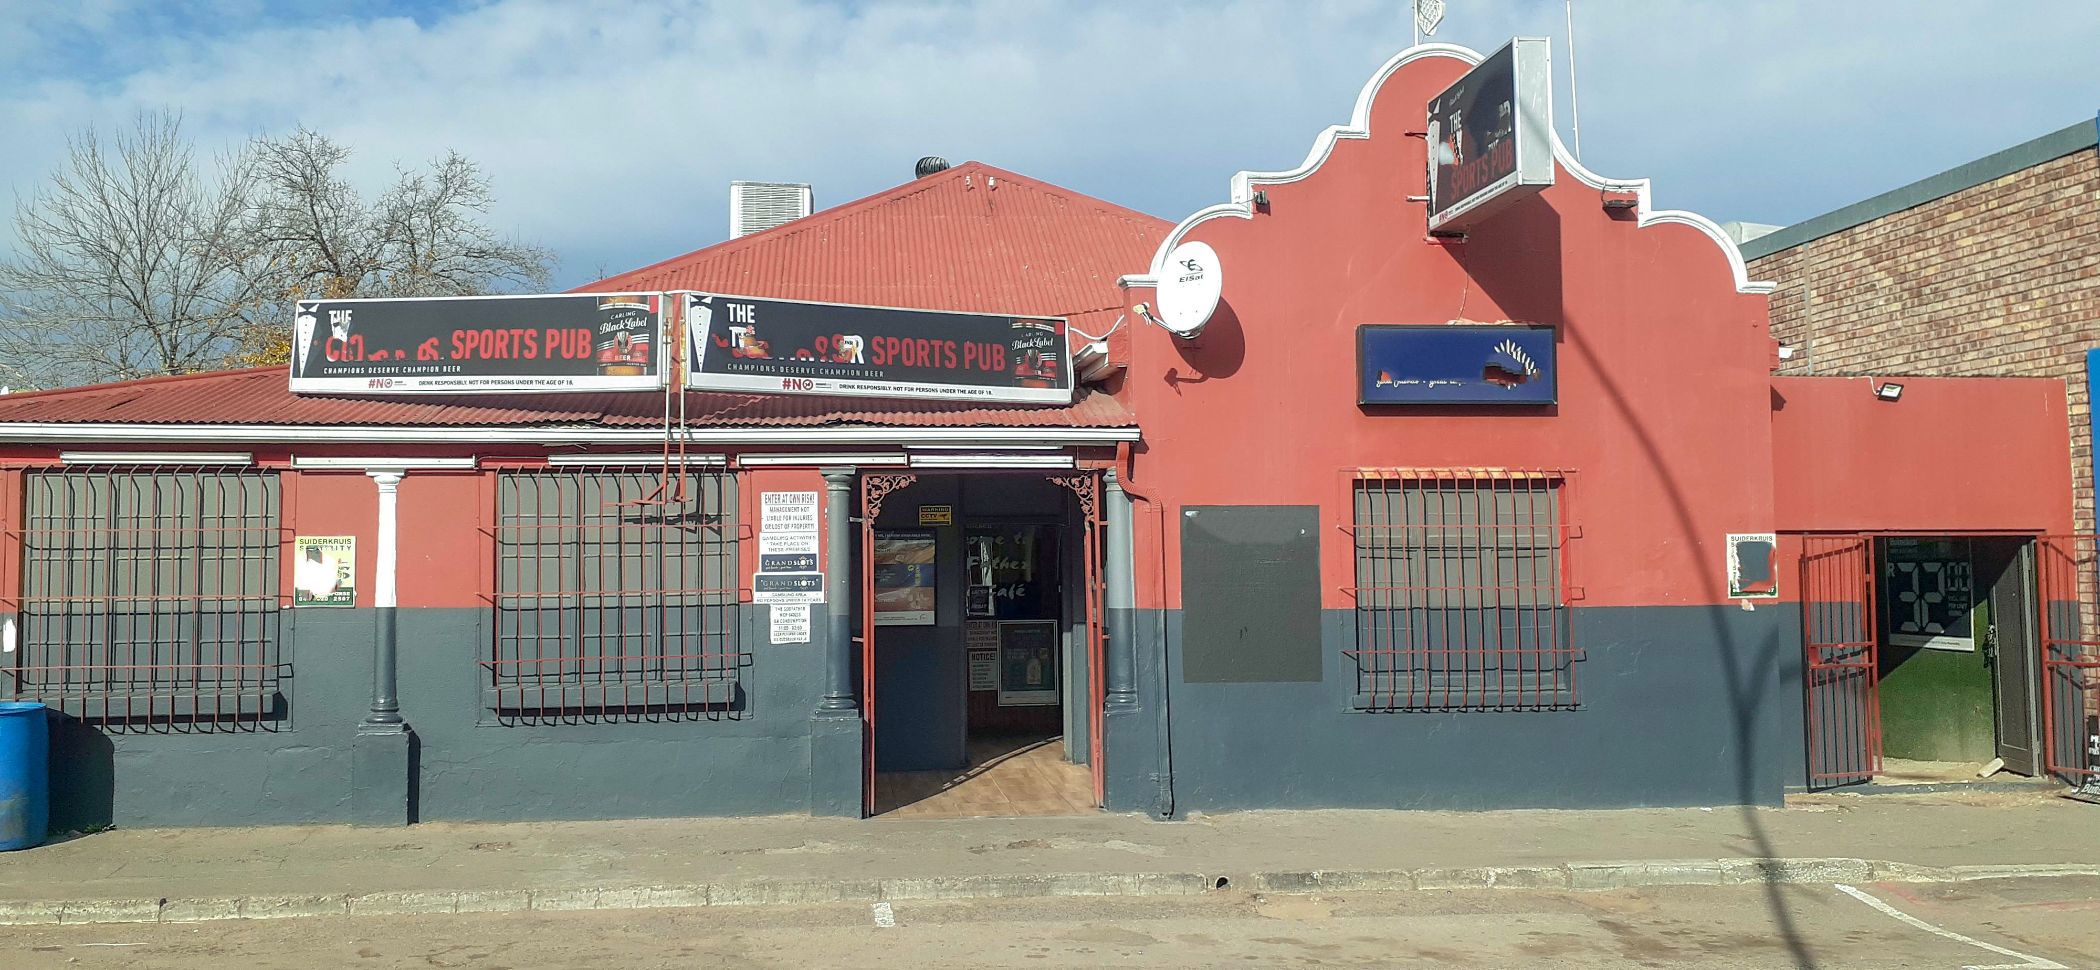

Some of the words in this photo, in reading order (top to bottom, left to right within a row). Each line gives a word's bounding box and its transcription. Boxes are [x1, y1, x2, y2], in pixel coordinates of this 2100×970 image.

[1449, 109, 1462, 134] THE
[1451, 153, 1488, 200] SPORTS
[1491, 139, 1513, 176] PUB
[610, 311, 636, 320] CARLING
[727, 303, 755, 323] THE
[600, 320, 625, 334] Black
[624, 317, 647, 330] Label
[451, 328, 538, 359] SPORTS
[545, 328, 592, 359] PUB
[1011, 339, 1035, 350] Black
[1034, 337, 1053, 348] Label
[871, 335, 957, 369] SPORTS
[963, 341, 1006, 372] PUB
[324, 366, 365, 374] CHAMPIONS
[368, 366, 400, 374] DESERVE
[727, 363, 776, 373] CHAMPIONS
[780, 367, 815, 375] DESERVE
[819, 368, 861, 377] CHAMPION
[765, 494, 781, 503] ENTER
[782, 494, 788, 503] AT
